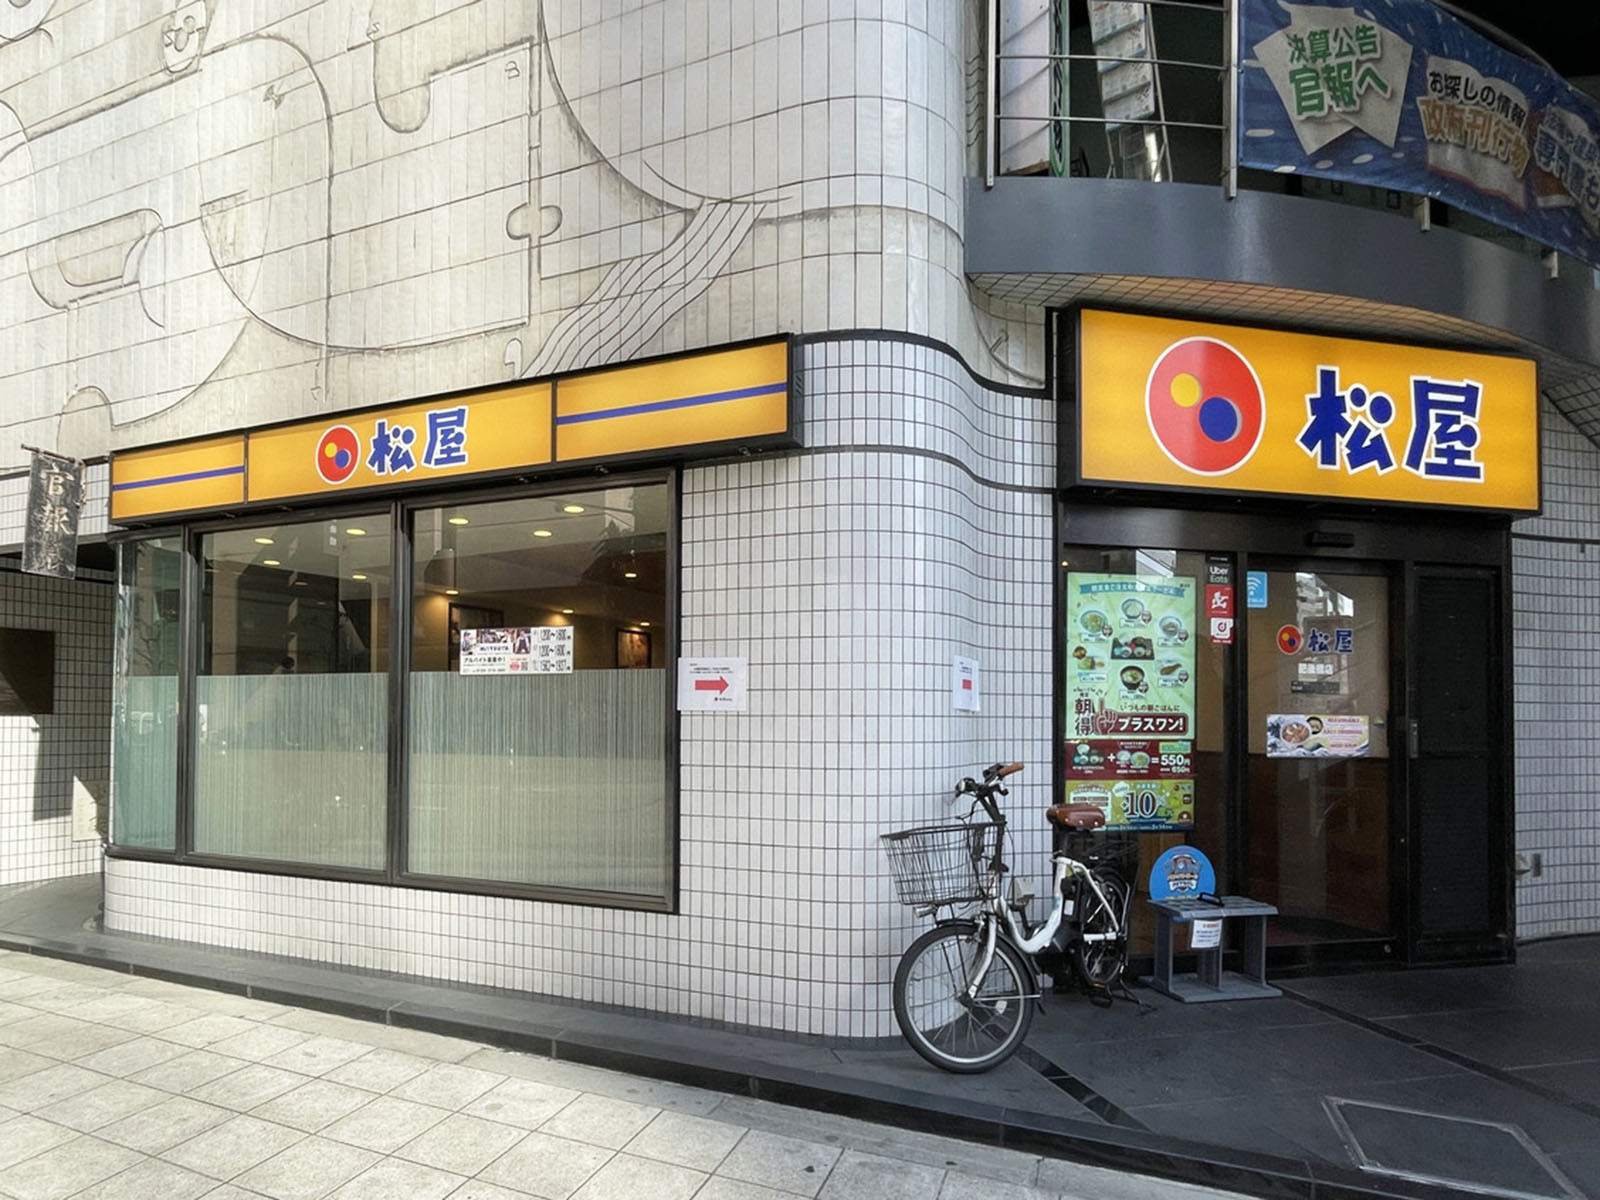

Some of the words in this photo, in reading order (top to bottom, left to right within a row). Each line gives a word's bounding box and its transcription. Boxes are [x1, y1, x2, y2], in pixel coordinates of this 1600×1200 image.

[1287, 24, 1379, 63] 決算公告
[1287, 60, 1391, 118] 官報へ
[1429, 71, 1526, 129] お探しの情報
[366, 405, 470, 477] 松屋
[1295, 364, 1486, 484] 松屋
[1209, 566, 1229, 575] Uber
[1209, 576, 1229, 584] Eats
[1307, 628, 1354, 654] 松屋
[1075, 697, 1095, 736] 朝得
[1118, 717, 1184, 732] プラスワン!
[1160, 754, 1191, 766] 550円
